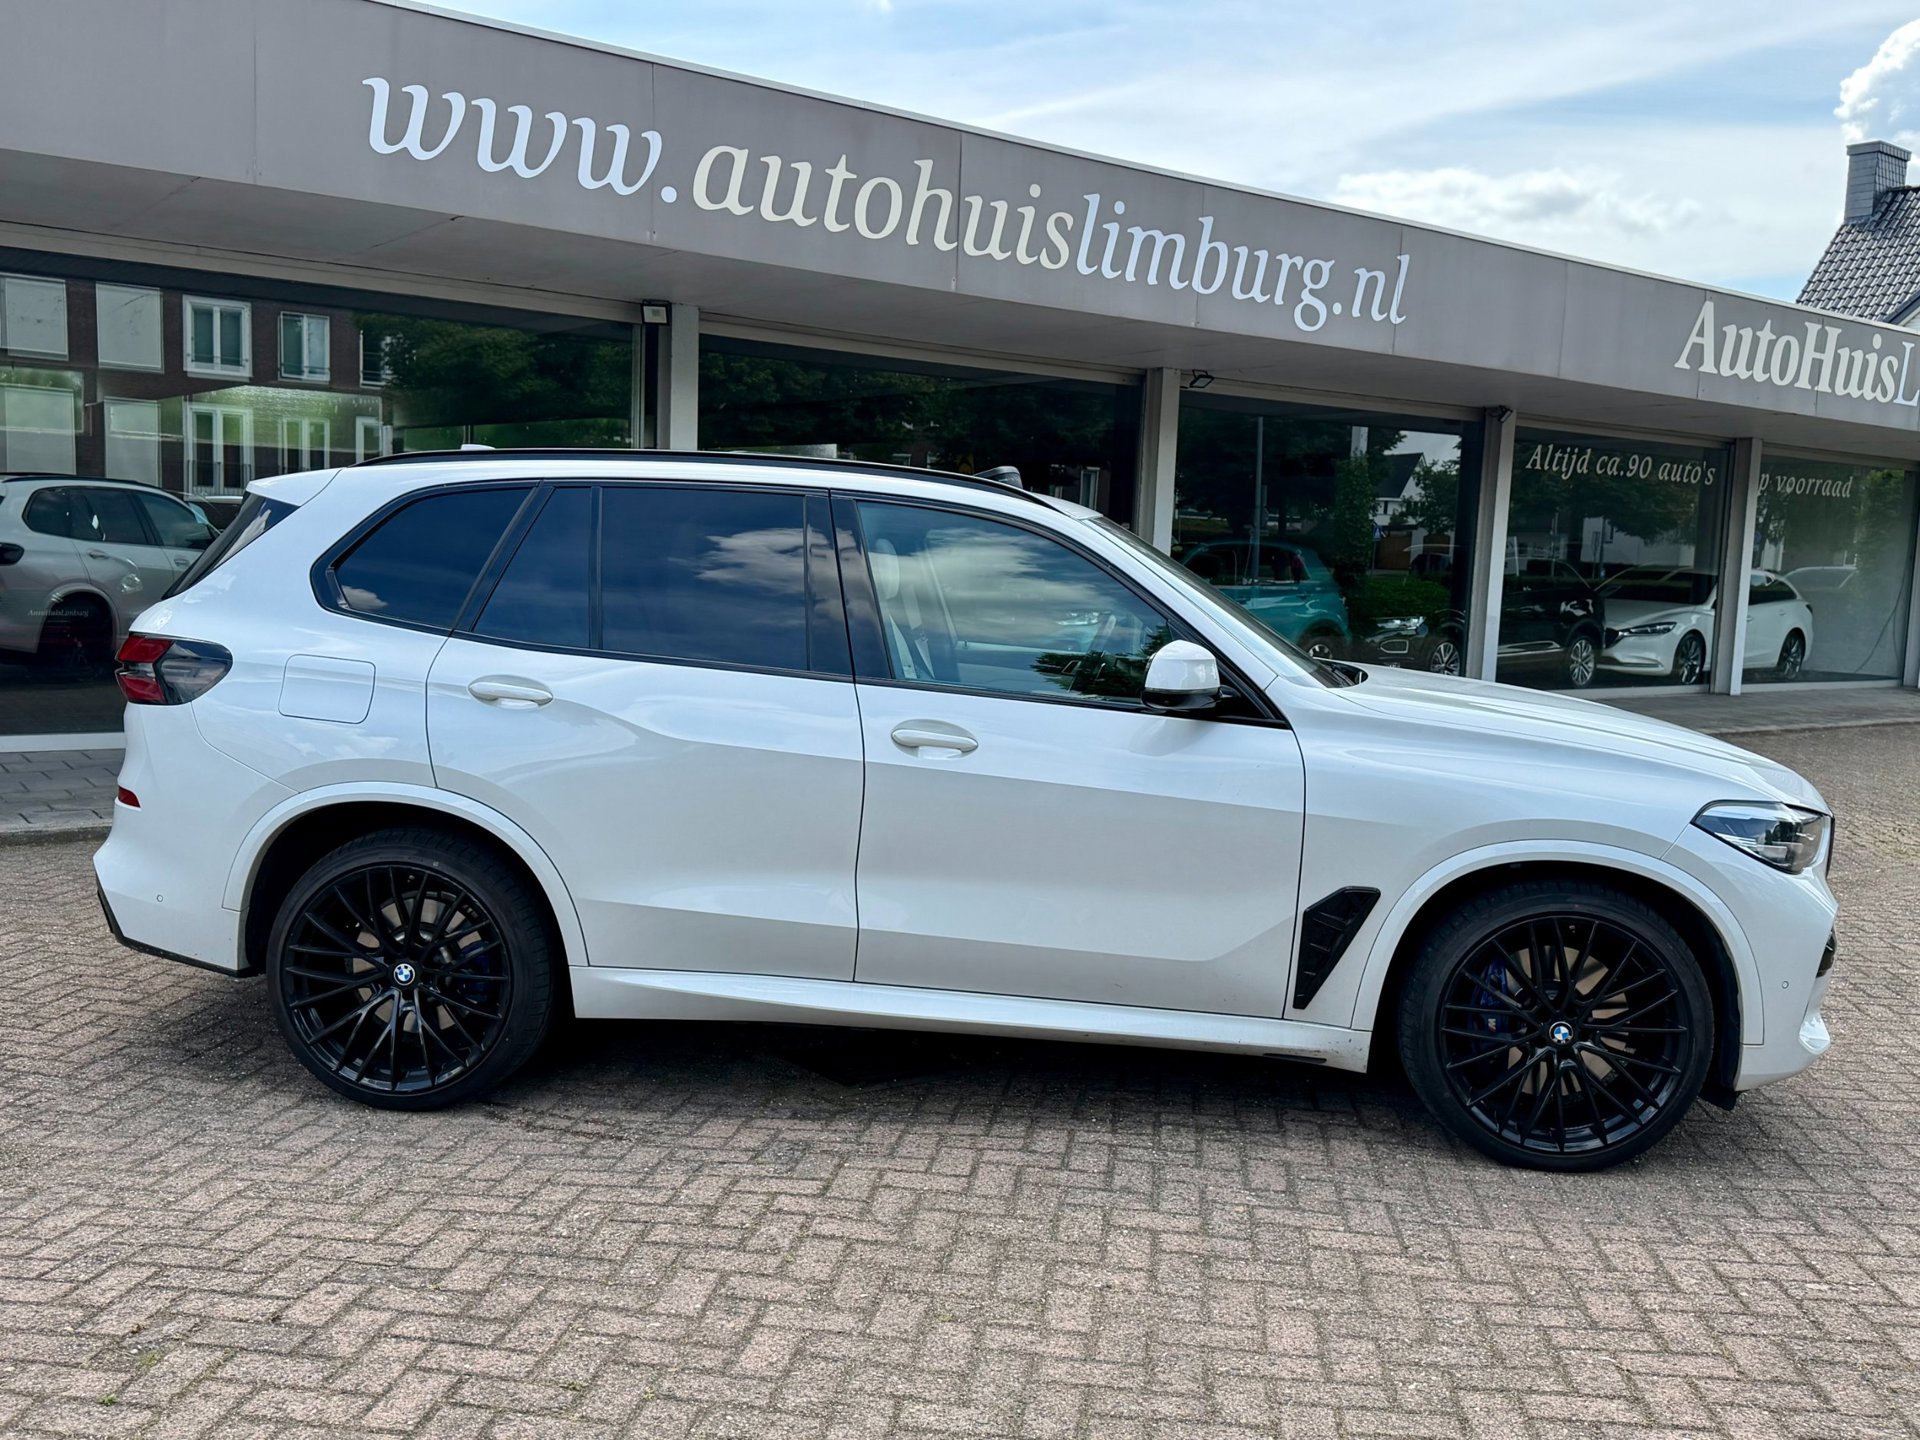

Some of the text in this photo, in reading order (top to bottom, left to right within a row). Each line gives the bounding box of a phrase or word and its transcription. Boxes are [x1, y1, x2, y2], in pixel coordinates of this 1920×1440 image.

[362, 77, 1410, 332] www.autohuislimburg.nl
[1674, 301, 1920, 407] AutoHuisL
[1525, 444, 1854, 498] Altijd ca.90 auto's p voorraad
